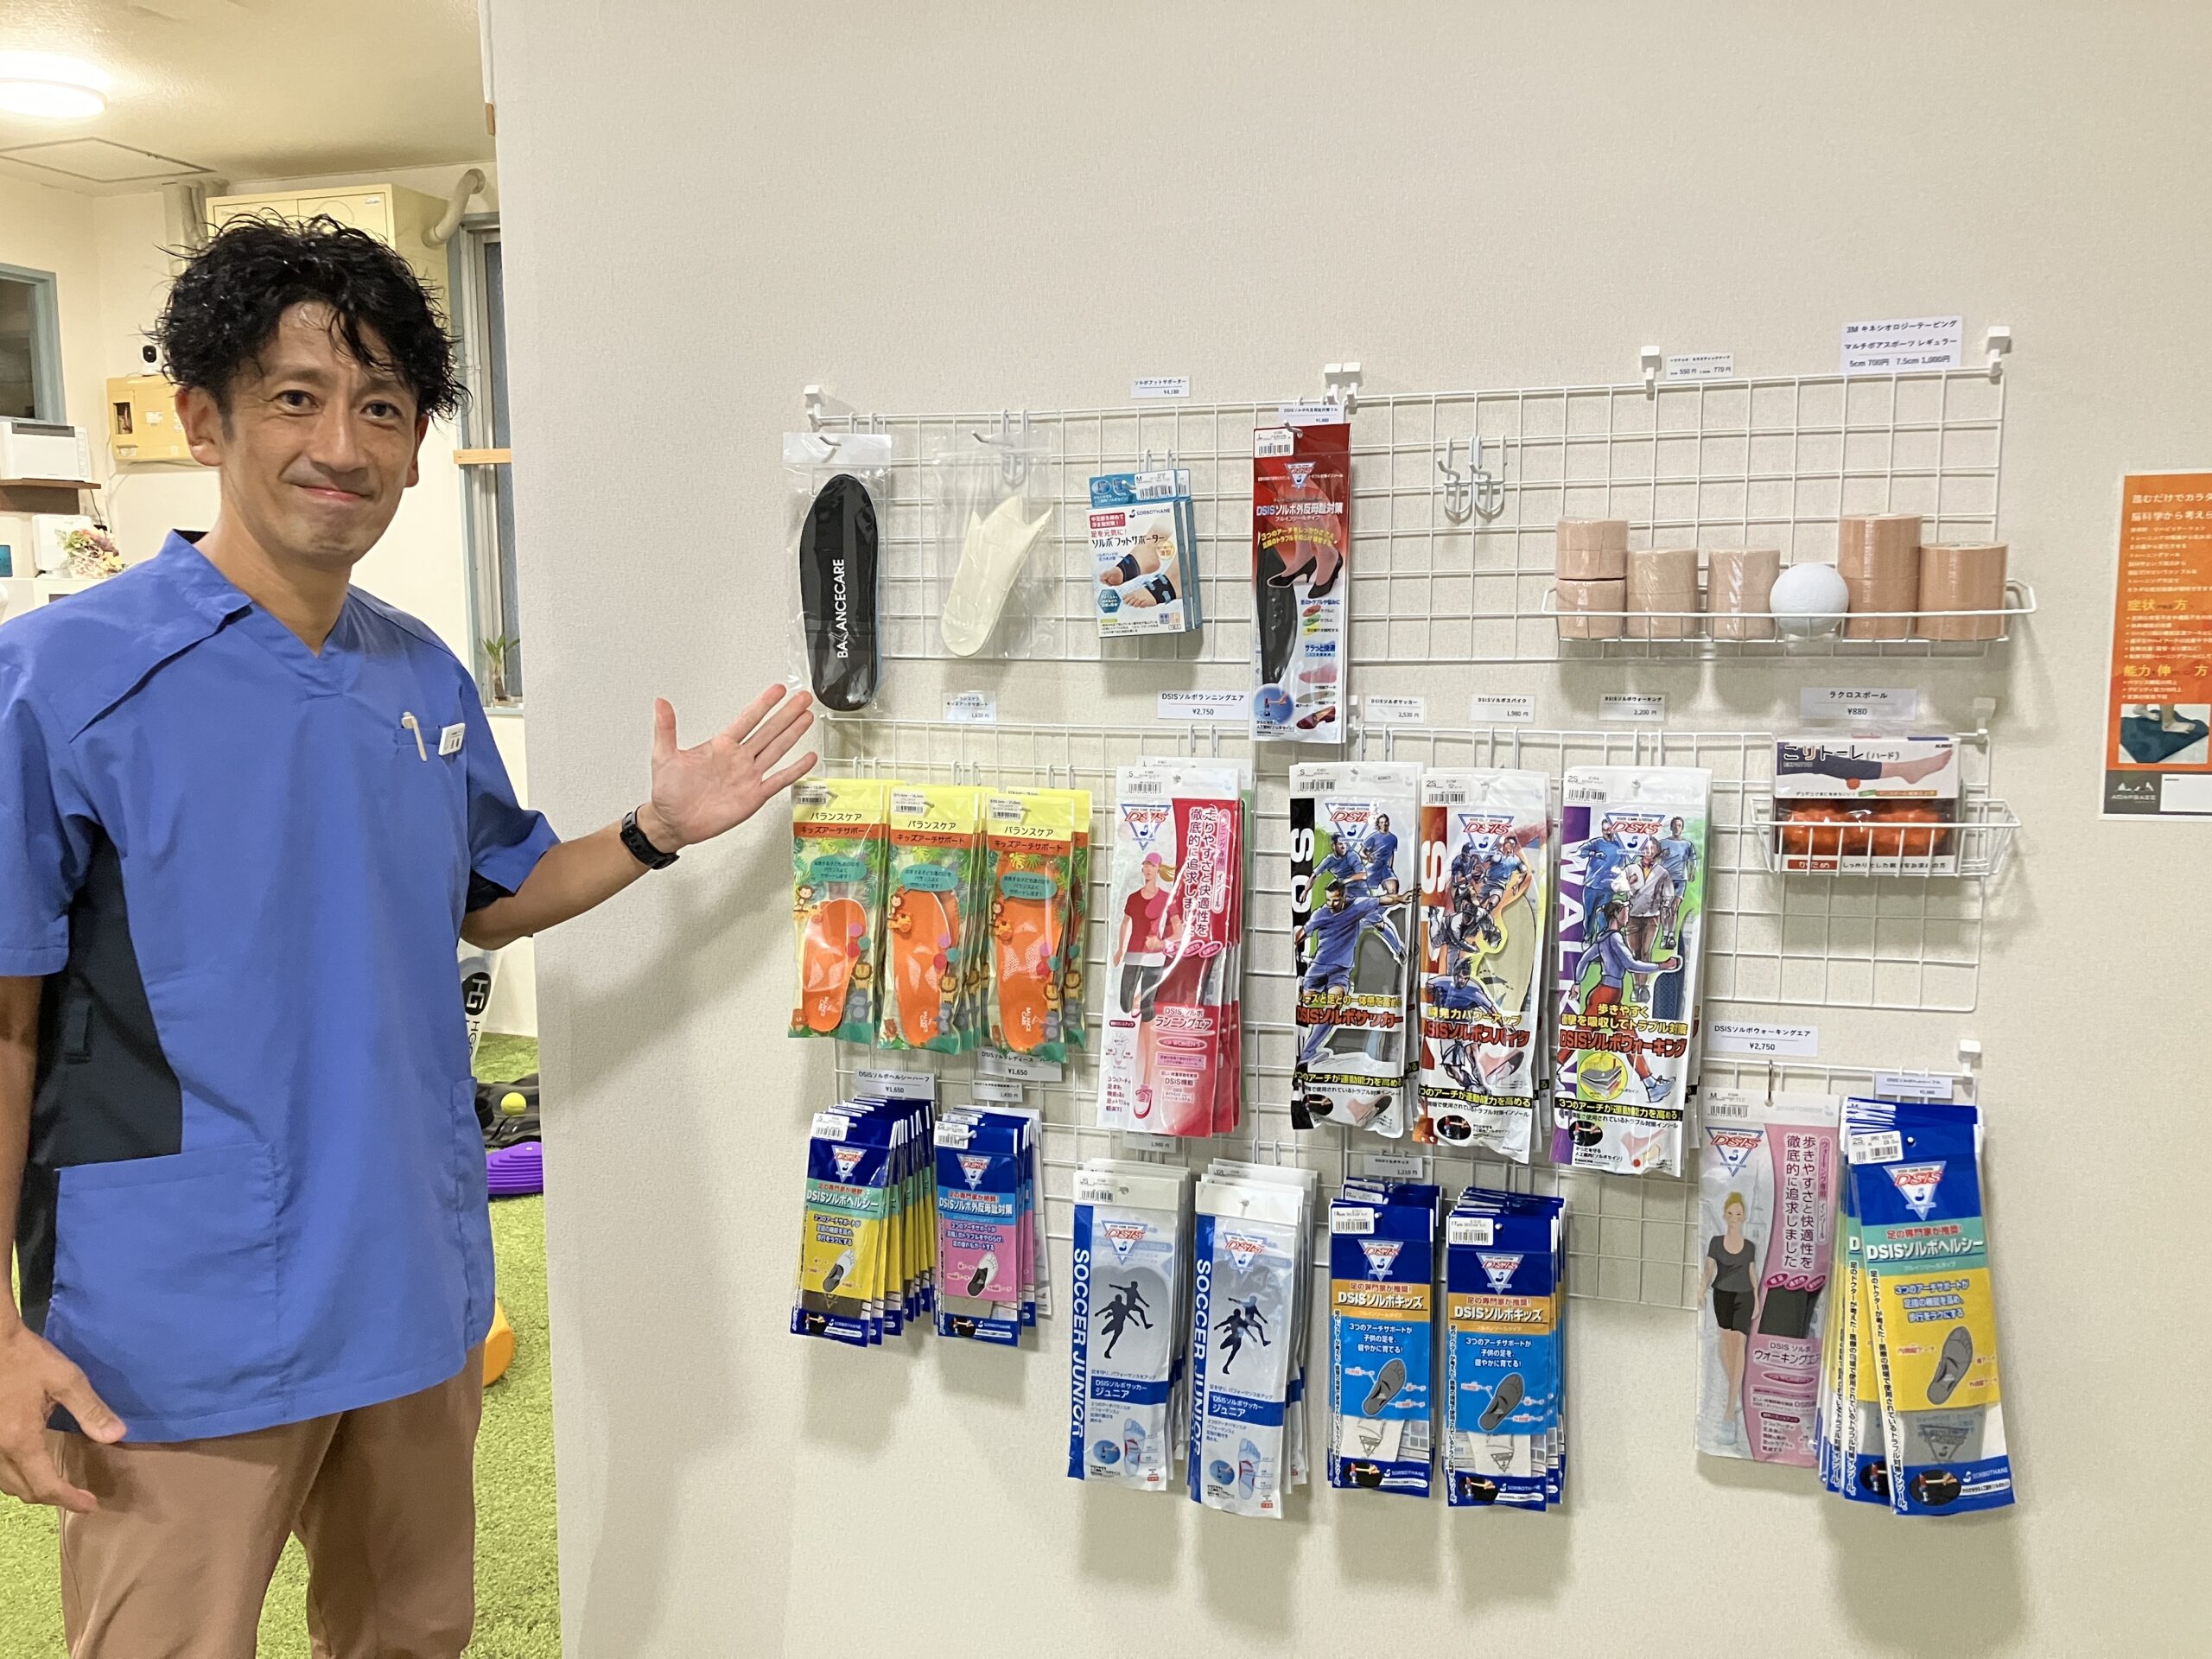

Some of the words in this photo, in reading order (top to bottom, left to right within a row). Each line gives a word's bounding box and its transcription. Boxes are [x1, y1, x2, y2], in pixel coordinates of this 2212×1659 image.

[1091, 534, 1165, 549] ソルボフットサポーター
[810, 812, 862, 821] バランスケア
[1331, 810, 1376, 823] DSI
[801, 826, 872, 835] キッズアーチサポート
[908, 820, 957, 830] バランスケア
[1005, 826, 1054, 836] バランスケア
[1463, 821, 1512, 835] DSIS
[1610, 821, 1662, 836] DSIS
[897, 834, 964, 845] キッズアーチサポート
[995, 840, 1063, 852] キッズアーチサポート
[1597, 1002, 1649, 1019] 歩きやすく
[1155, 1016, 1212, 1030] ランニングエア
[1714, 1026, 1811, 1038] DSISソルボウォーキングエア
[1559, 1028, 1688, 1058] DSISソルボウォーキング
[1749, 1042, 1776, 1051] ¥2,750
[858, 1071, 931, 1082] DSISソルボヘルシーハーフ
[1419, 1087, 1532, 1108] つのアーチが運動能力を高める
[1709, 1091, 1718, 1100] M
[1710, 1135, 1761, 1149] DSIS
[1852, 1137, 1864, 1146] 2S
[1894, 1172, 1943, 1187] DSIS
[806, 1190, 880, 1210] DSISソルボヘルシー
[1783, 1135, 1801, 1268] 徹底的に追求しました
[1799, 1135, 1816, 1269] 歩きやすさと快適性を
[1104, 1228, 1146, 1241] DSIS
[1867, 1237, 1985, 1261] DSISソルボヘルシー
[1483, 1260, 1520, 1270] DSIS
[1072, 1249, 1090, 1345] SOCCER
[1338, 1290, 1424, 1310] DSISソルボキッズ
[1194, 1258, 1211, 1361] SOCCER
[1453, 1306, 1544, 1323] DSISソルボキッズ
[1349, 1322, 1413, 1334] 3つのアーチサポートが
[1465, 1337, 1533, 1347] 3つのアーチサポートが
[1770, 1342, 1789, 1351] DSIS
[1095, 1379, 1148, 1391] DSISソルボサッカー
[1071, 1348, 1087, 1439] JUNIOR
[1095, 1387, 1130, 1399] ジュニア
[1211, 1395, 1265, 1410] DSISソルボサッカー
[1211, 1403, 1247, 1418] ジュニア
